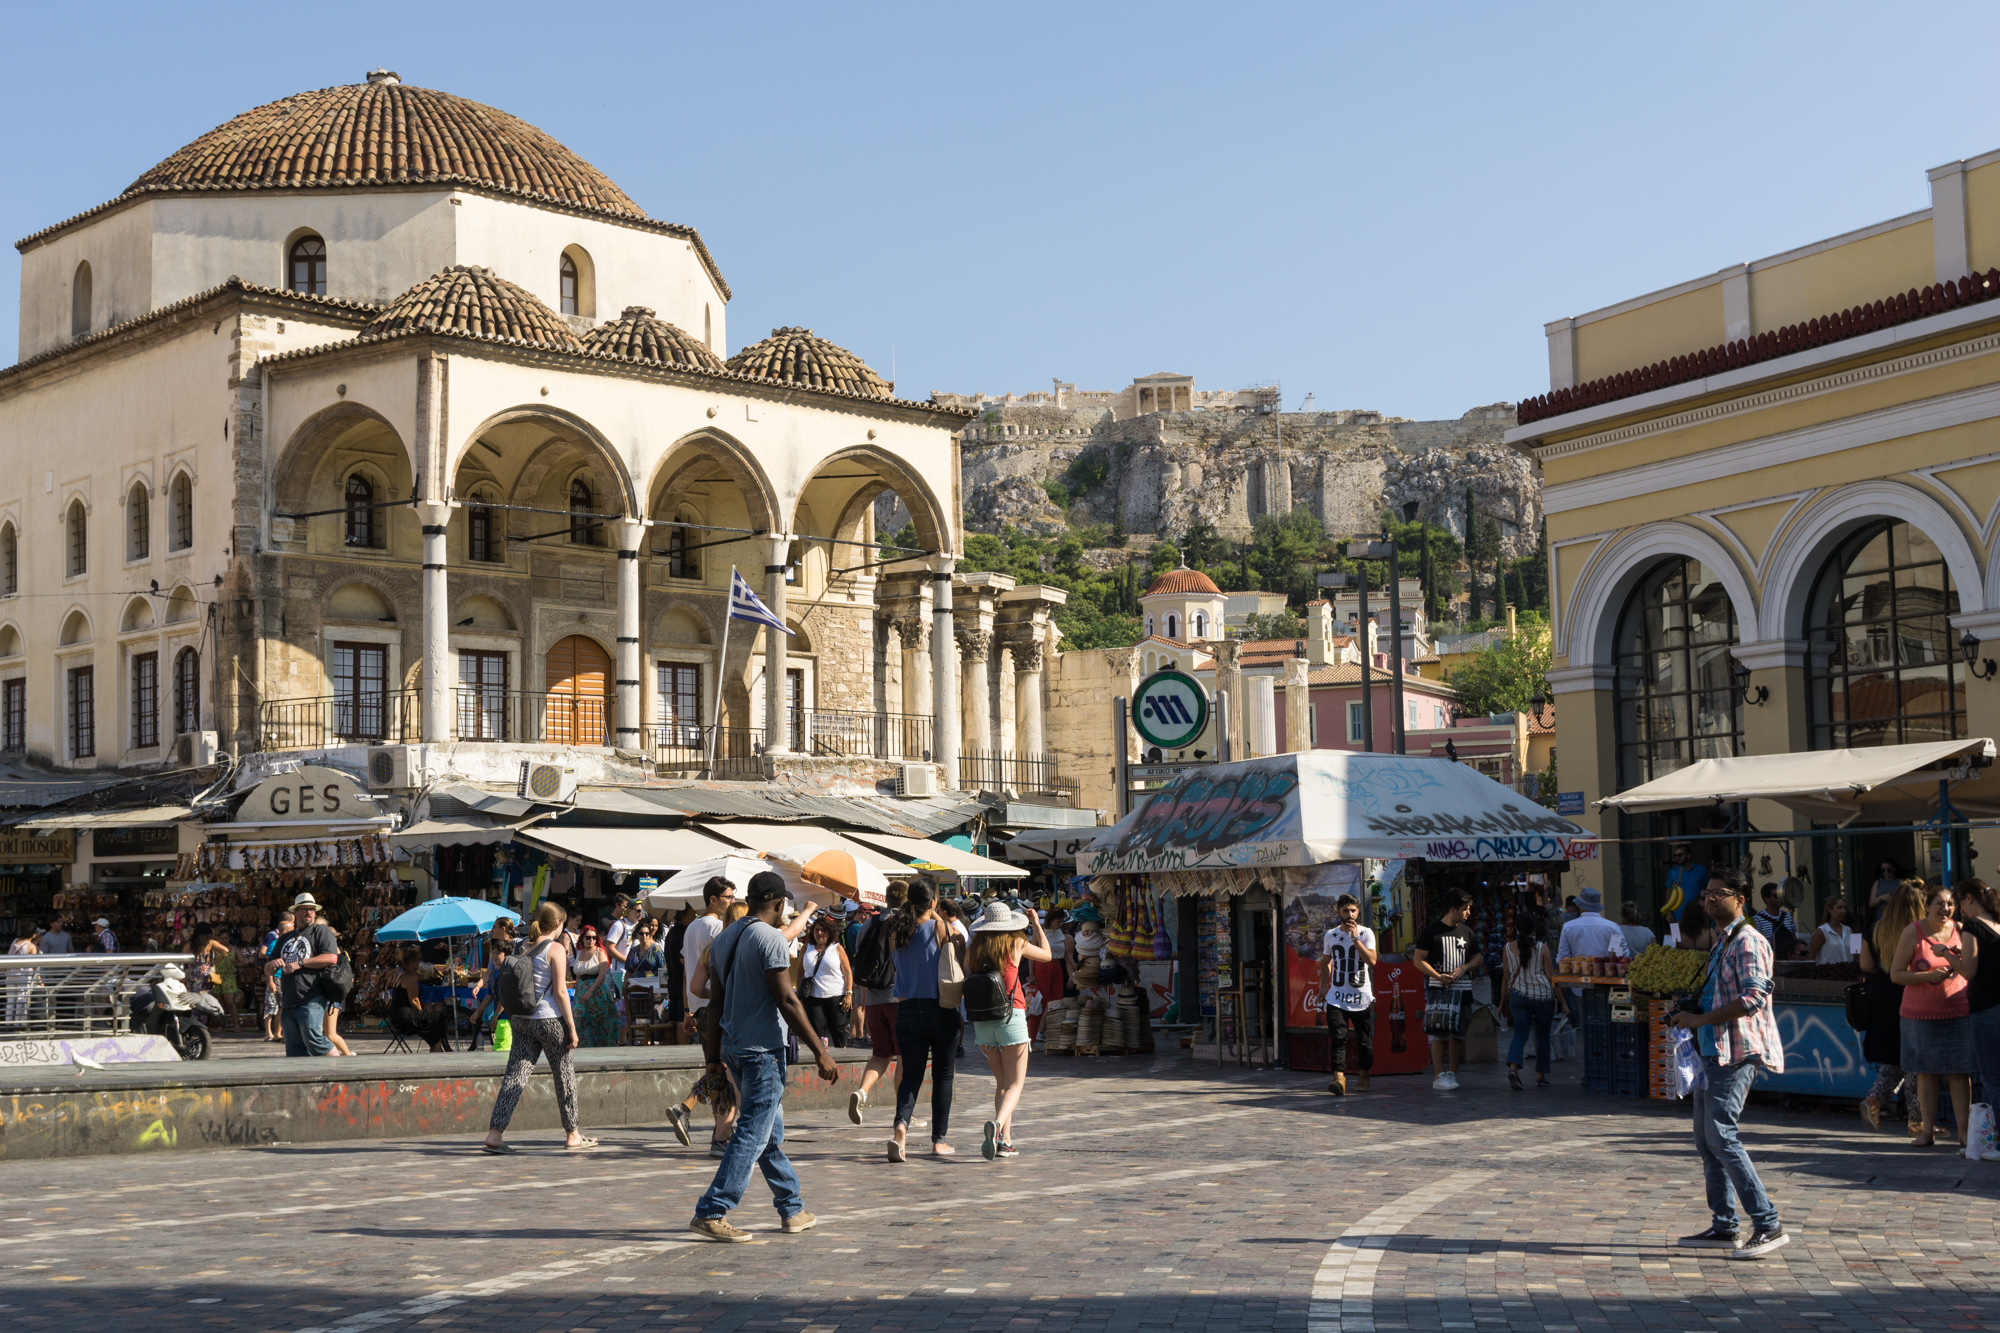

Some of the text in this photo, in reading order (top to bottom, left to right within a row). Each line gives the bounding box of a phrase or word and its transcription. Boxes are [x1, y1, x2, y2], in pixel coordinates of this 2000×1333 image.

[270, 784, 341, 815] GES
[139, 829, 171, 842] TERRA
[0, 838, 68, 856] old mosque
